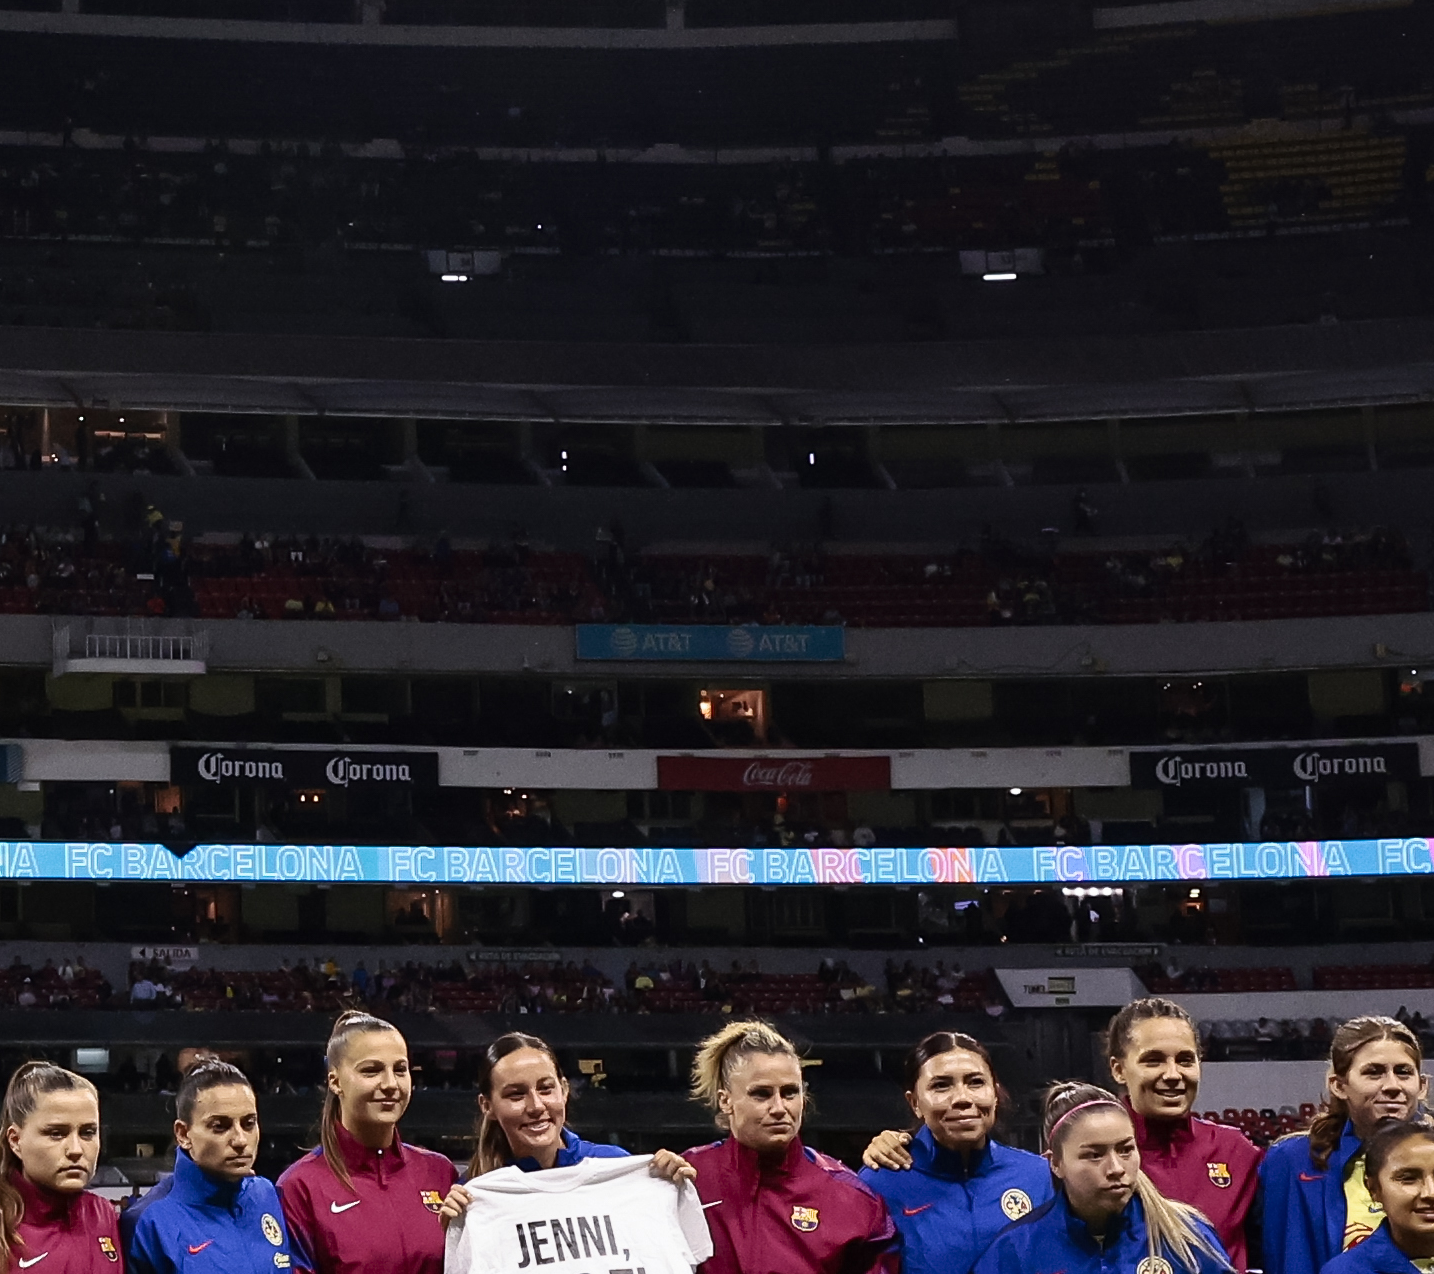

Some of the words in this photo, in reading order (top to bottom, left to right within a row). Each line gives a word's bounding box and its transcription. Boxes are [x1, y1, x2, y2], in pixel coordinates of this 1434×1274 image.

[642, 634, 691, 652] AT&T
[759, 634, 809, 652] AT&T
[198, 752, 284, 785] Corona
[326, 757, 412, 788] Corona
[1156, 756, 1248, 787] Corona
[1293, 753, 1386, 782] Corona
[64, 842, 114, 879] FC
[120, 843, 365, 882] BARCELONA
[387, 845, 436, 883] FC
[443, 846, 683, 884] BARCELONA
[707, 848, 755, 884] FC
[763, 847, 1008, 884] BARCELONA
[1034, 846, 1084, 882] FC
[1091, 841, 1352, 881] BARCELONA
[1377, 837, 1433, 876] FC
[515, 1215, 630, 1269] JENNI,
